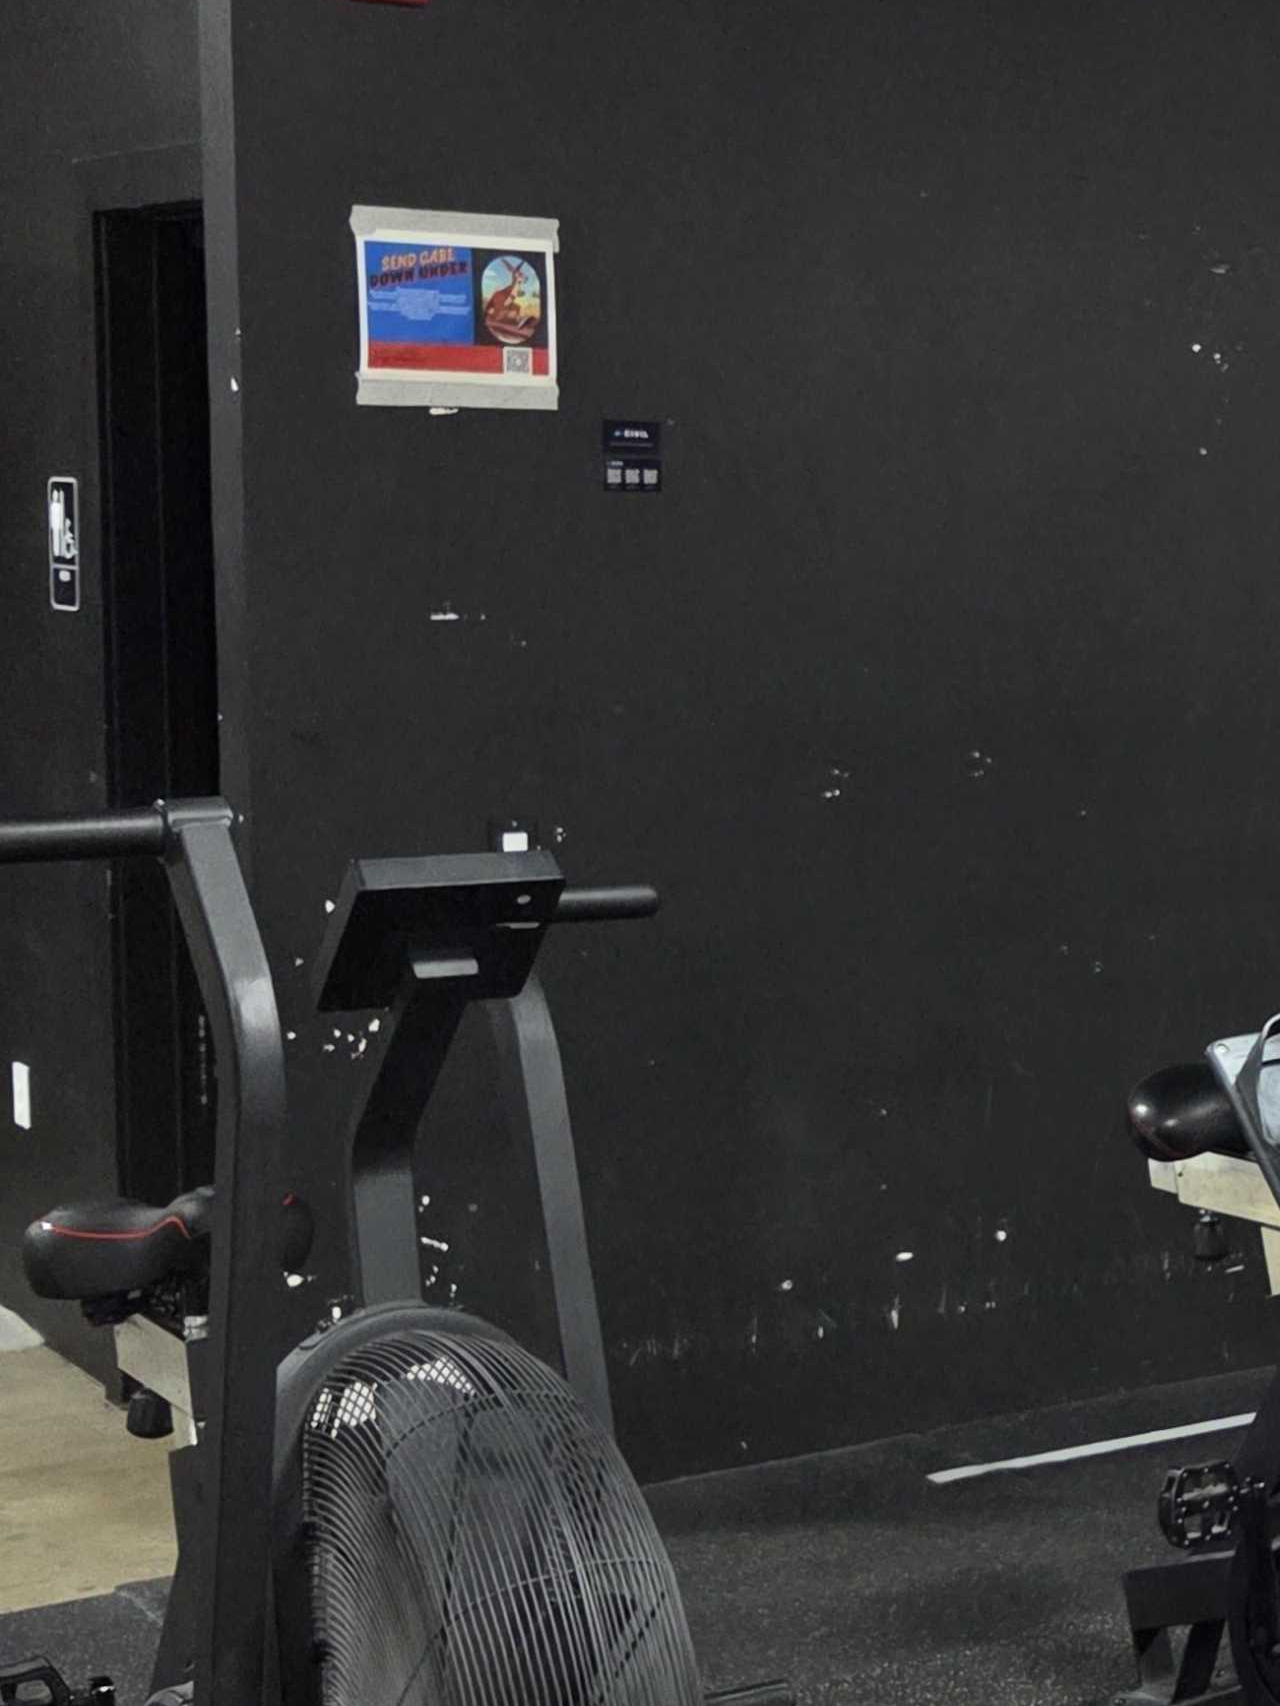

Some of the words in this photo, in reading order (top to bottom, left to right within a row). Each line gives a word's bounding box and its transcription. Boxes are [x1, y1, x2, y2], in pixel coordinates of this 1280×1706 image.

[382, 253, 416, 271] SEND
[370, 269, 414, 288] DOWN
[419, 261, 467, 280] UNDER
